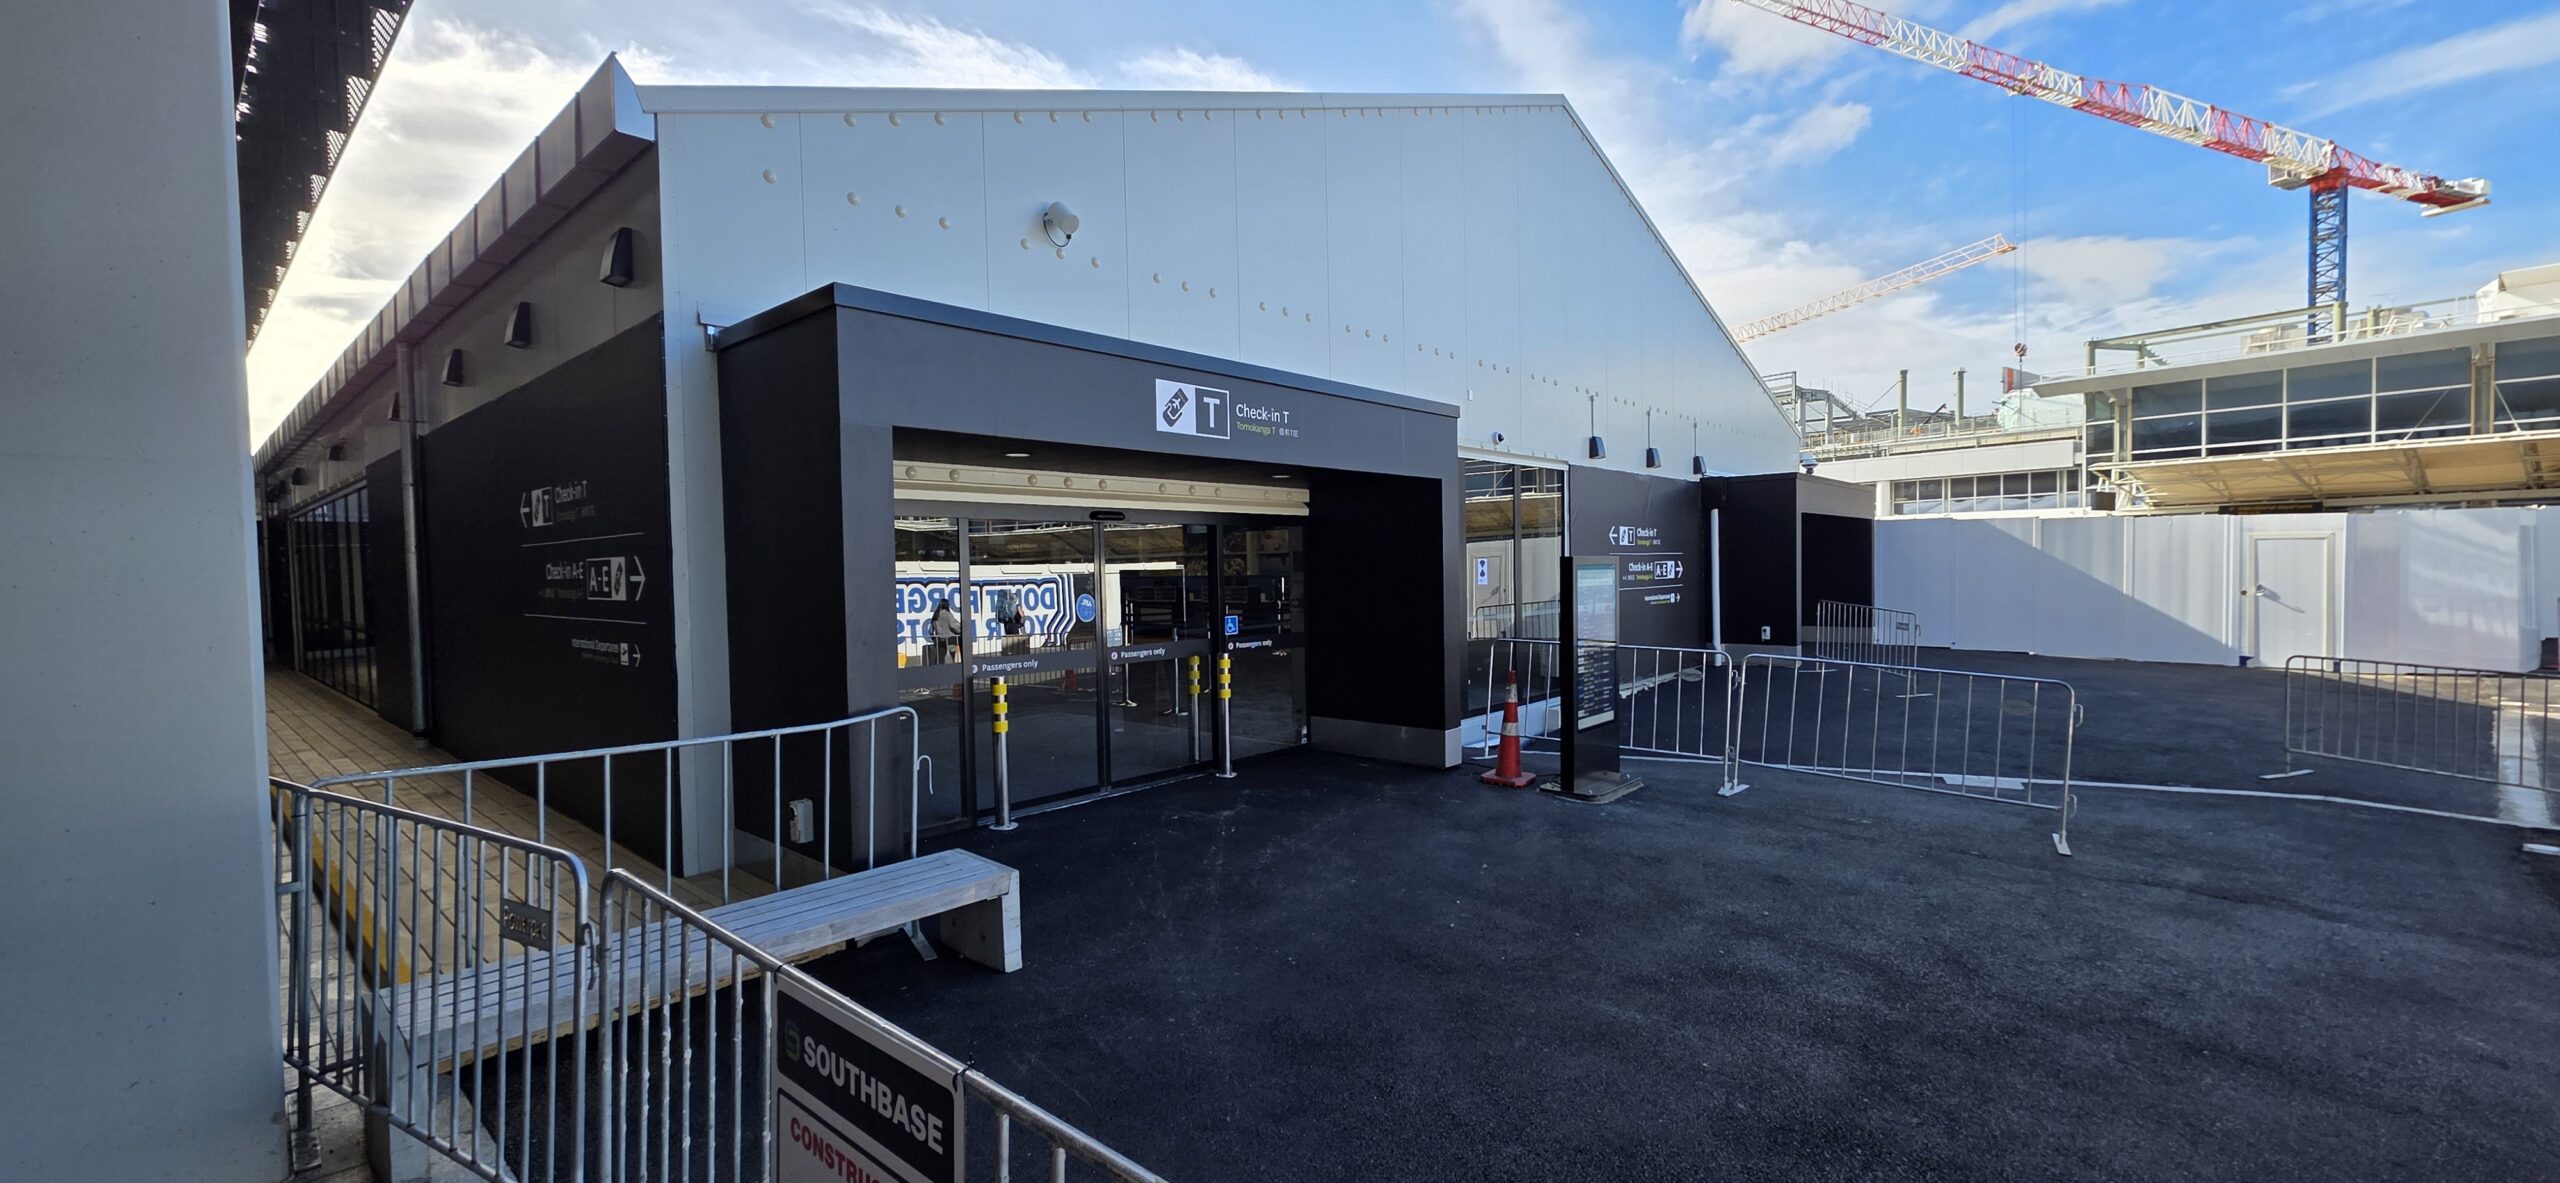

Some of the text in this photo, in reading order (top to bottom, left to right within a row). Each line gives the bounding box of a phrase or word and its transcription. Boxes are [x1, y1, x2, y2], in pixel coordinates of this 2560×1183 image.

[1203, 396, 1220, 428] T
[1236, 402, 1290, 424] Check-in T
[555, 480, 582, 504] Check-in
[543, 494, 550, 518] T
[1629, 530, 1633, 542] T
[546, 561, 571, 580] Check-in
[589, 565, 610, 592] A-E
[1656, 564, 1668, 576] A-E
[1120, 647, 1166, 660] Passengers only
[1236, 638, 1272, 650] Passengers only
[982, 659, 1038, 673] Passengers only
[803, 1035, 944, 1155] SOUTHBASE
[790, 1116, 880, 1183] CONSTRU
